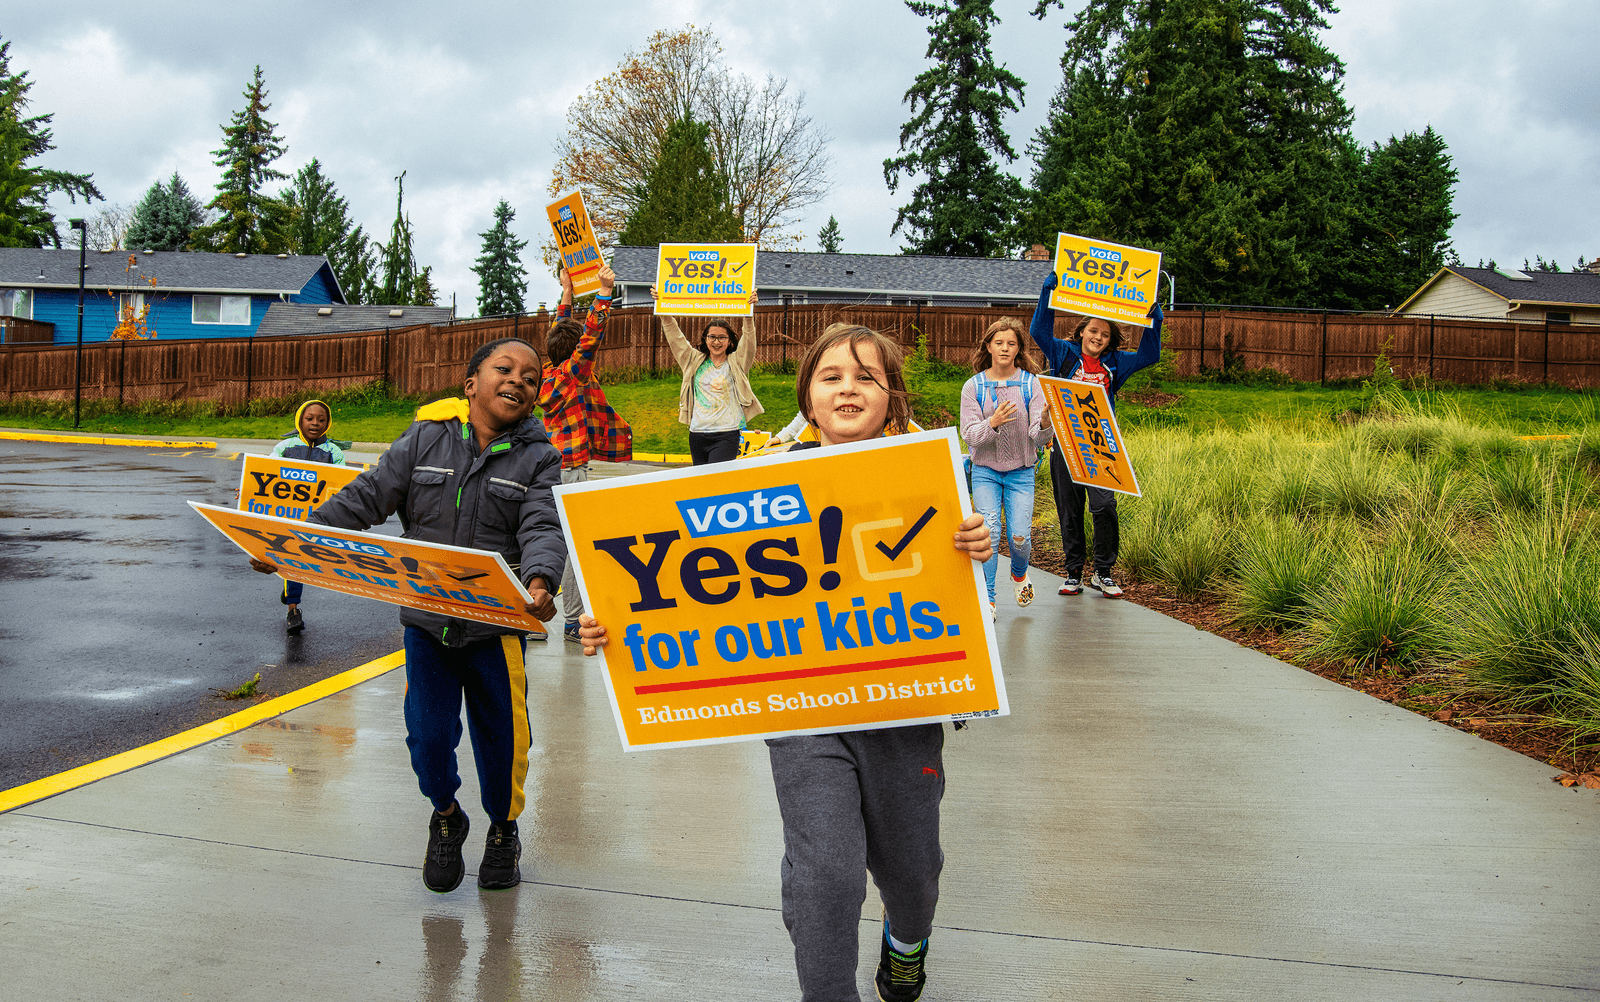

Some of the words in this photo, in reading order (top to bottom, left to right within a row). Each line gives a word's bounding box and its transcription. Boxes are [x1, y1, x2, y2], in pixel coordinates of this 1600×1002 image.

[553, 212, 582, 247] Yes!
[665, 257, 727, 279] Yes!
[690, 251, 718, 260] vote
[1064, 248, 1129, 282] Yes!
[1090, 248, 1120, 261] vote
[664, 280, 684, 293] for
[687, 283, 710, 294] our
[713, 280, 746, 294] kids.
[1061, 272, 1082, 290] for
[1085, 281, 1110, 295] our
[1112, 283, 1148, 303] kids.
[1056, 295, 1091, 308] Edmonds
[1092, 303, 1117, 313] School
[1057, 420, 1071, 448] School
[1060, 387, 1075, 411] for
[1069, 413, 1085, 440] our
[1078, 442, 1098, 478] kids.
[1075, 390, 1116, 461] Yes!
[1100, 420, 1117, 452] vote
[250, 471, 327, 504] Yes!
[281, 469, 316, 481] vote
[248, 498, 272, 516] for
[275, 505, 304, 520] our
[686, 491, 800, 533] vote
[228, 524, 423, 580] Yes!
[296, 531, 385, 555] vote
[592, 505, 843, 613] Yes!
[265, 552, 324, 573] for
[333, 568, 399, 589] our
[406, 579, 515, 611] kids.
[379, 592, 446, 611] School
[450, 607, 530, 627] District
[624, 622, 701, 673] for
[714, 617, 805, 663] our
[815, 591, 961, 652] kids.
[636, 697, 762, 725] Edmonds
[766, 686, 857, 713] School
[864, 673, 976, 703] District
